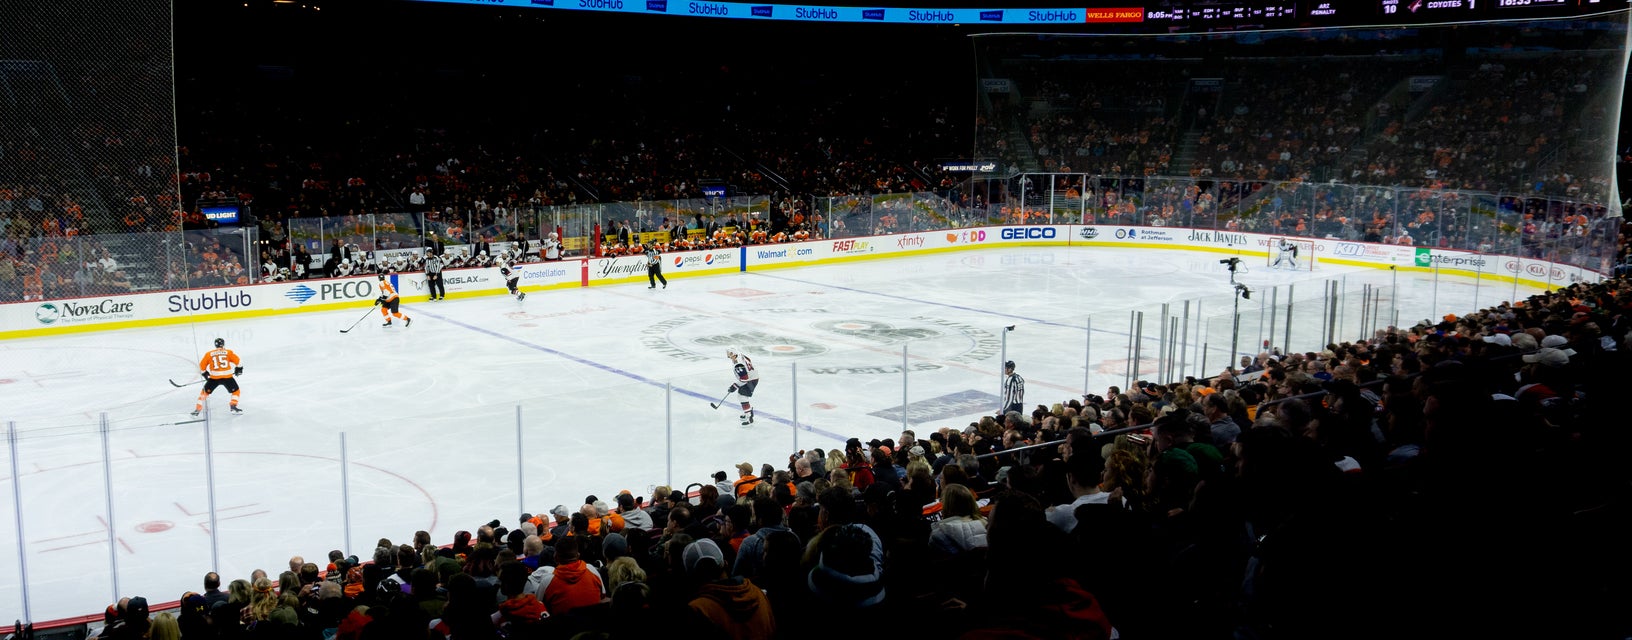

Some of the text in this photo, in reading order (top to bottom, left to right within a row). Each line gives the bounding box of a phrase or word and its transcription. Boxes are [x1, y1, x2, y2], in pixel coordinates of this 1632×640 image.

[688, 2, 729, 16] StubHub
[795, 7, 838, 19] StubHub
[908, 9, 954, 22] StubHub
[1028, 10, 1077, 21] StubHub
[1384, 5, 1397, 14] 10
[970, 230, 986, 243] DD
[1001, 227, 1056, 240] GEICO
[1188, 229, 1211, 242] JACK
[897, 235, 925, 249] xfinity
[685, 255, 702, 264] pepsi
[715, 252, 732, 261] pepsi
[757, 249, 787, 259] Walmart
[523, 268, 566, 280] Constellation
[597, 258, 650, 278] Yuenglin
[1530, 265, 1546, 275] KIA
[321, 280, 372, 300] PECO
[168, 290, 252, 313] StubHub
[61, 299, 134, 318] NovaCare
[212, 355, 229, 370] 15
